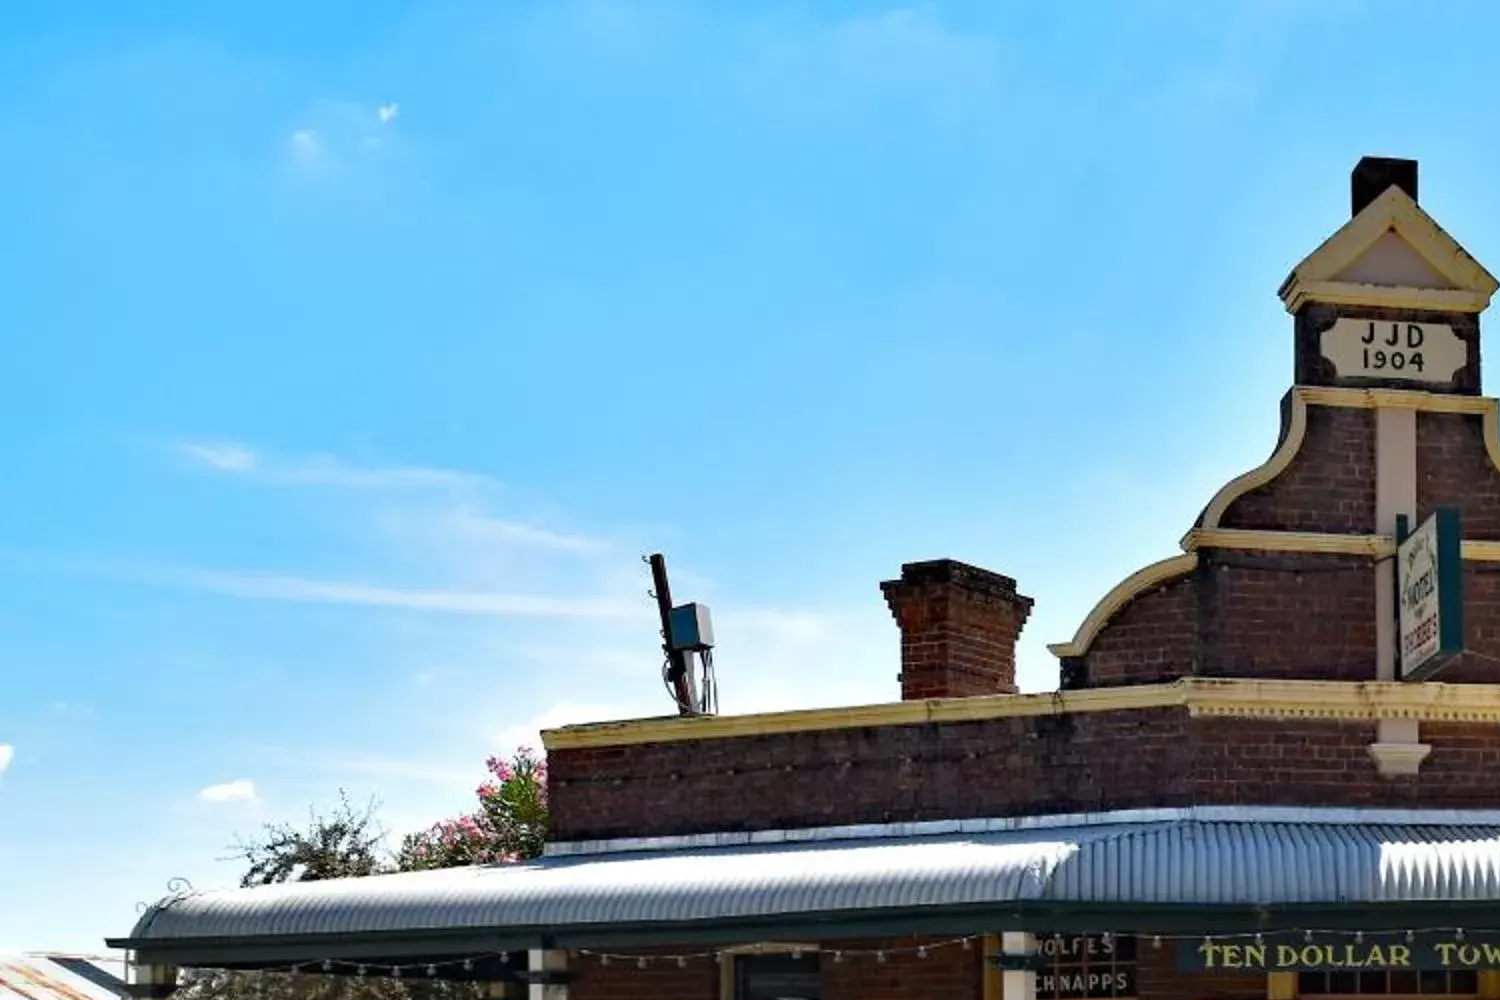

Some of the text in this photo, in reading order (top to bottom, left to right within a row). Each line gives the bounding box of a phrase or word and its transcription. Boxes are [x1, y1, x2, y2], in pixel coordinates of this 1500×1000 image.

[1363, 349, 1424, 373] 1904
[1199, 944, 1266, 968] TEN
[1276, 944, 1411, 968] DOLLAR
[1035, 973, 1129, 993] CHNAPPS
